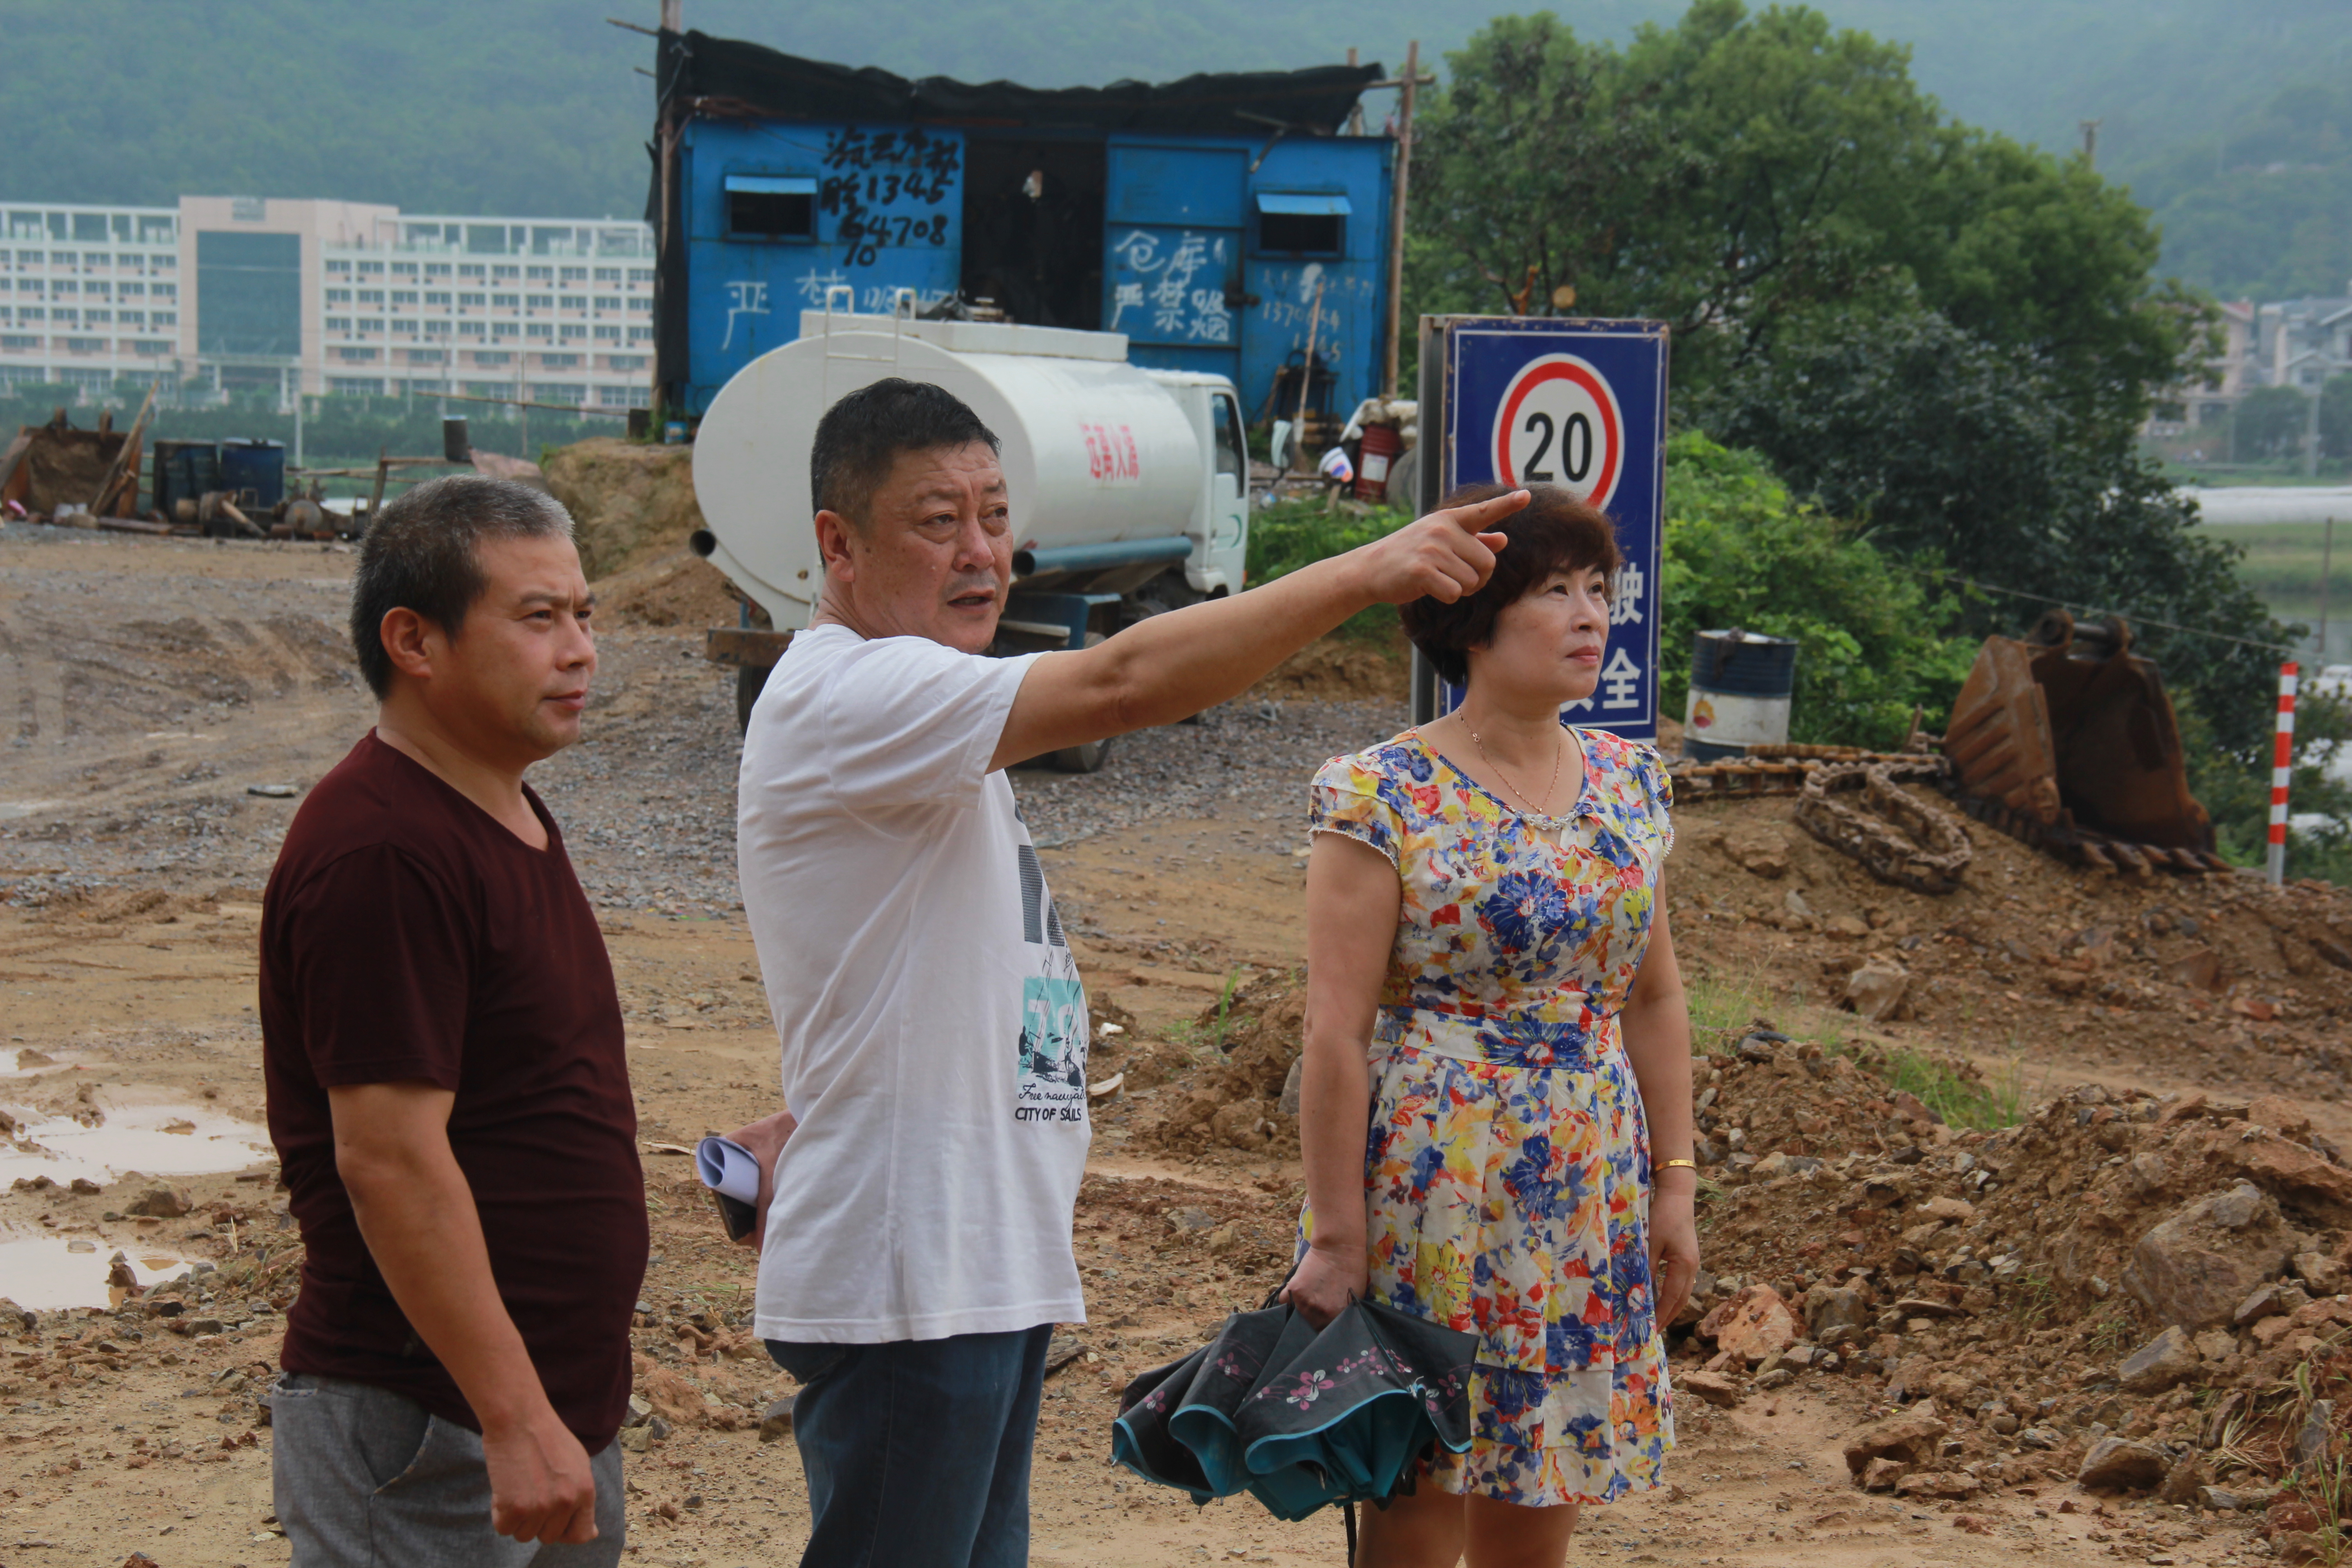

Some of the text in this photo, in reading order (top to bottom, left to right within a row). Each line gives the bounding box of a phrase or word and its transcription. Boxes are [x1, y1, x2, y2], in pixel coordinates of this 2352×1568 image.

[840, 206, 948, 247] 64708
[843, 242, 876, 267] 10
[1524, 412, 1592, 482] 20
[1019, 1083, 1043, 1100] Free
[1014, 1107, 1082, 1122] CITY OF SAILS
